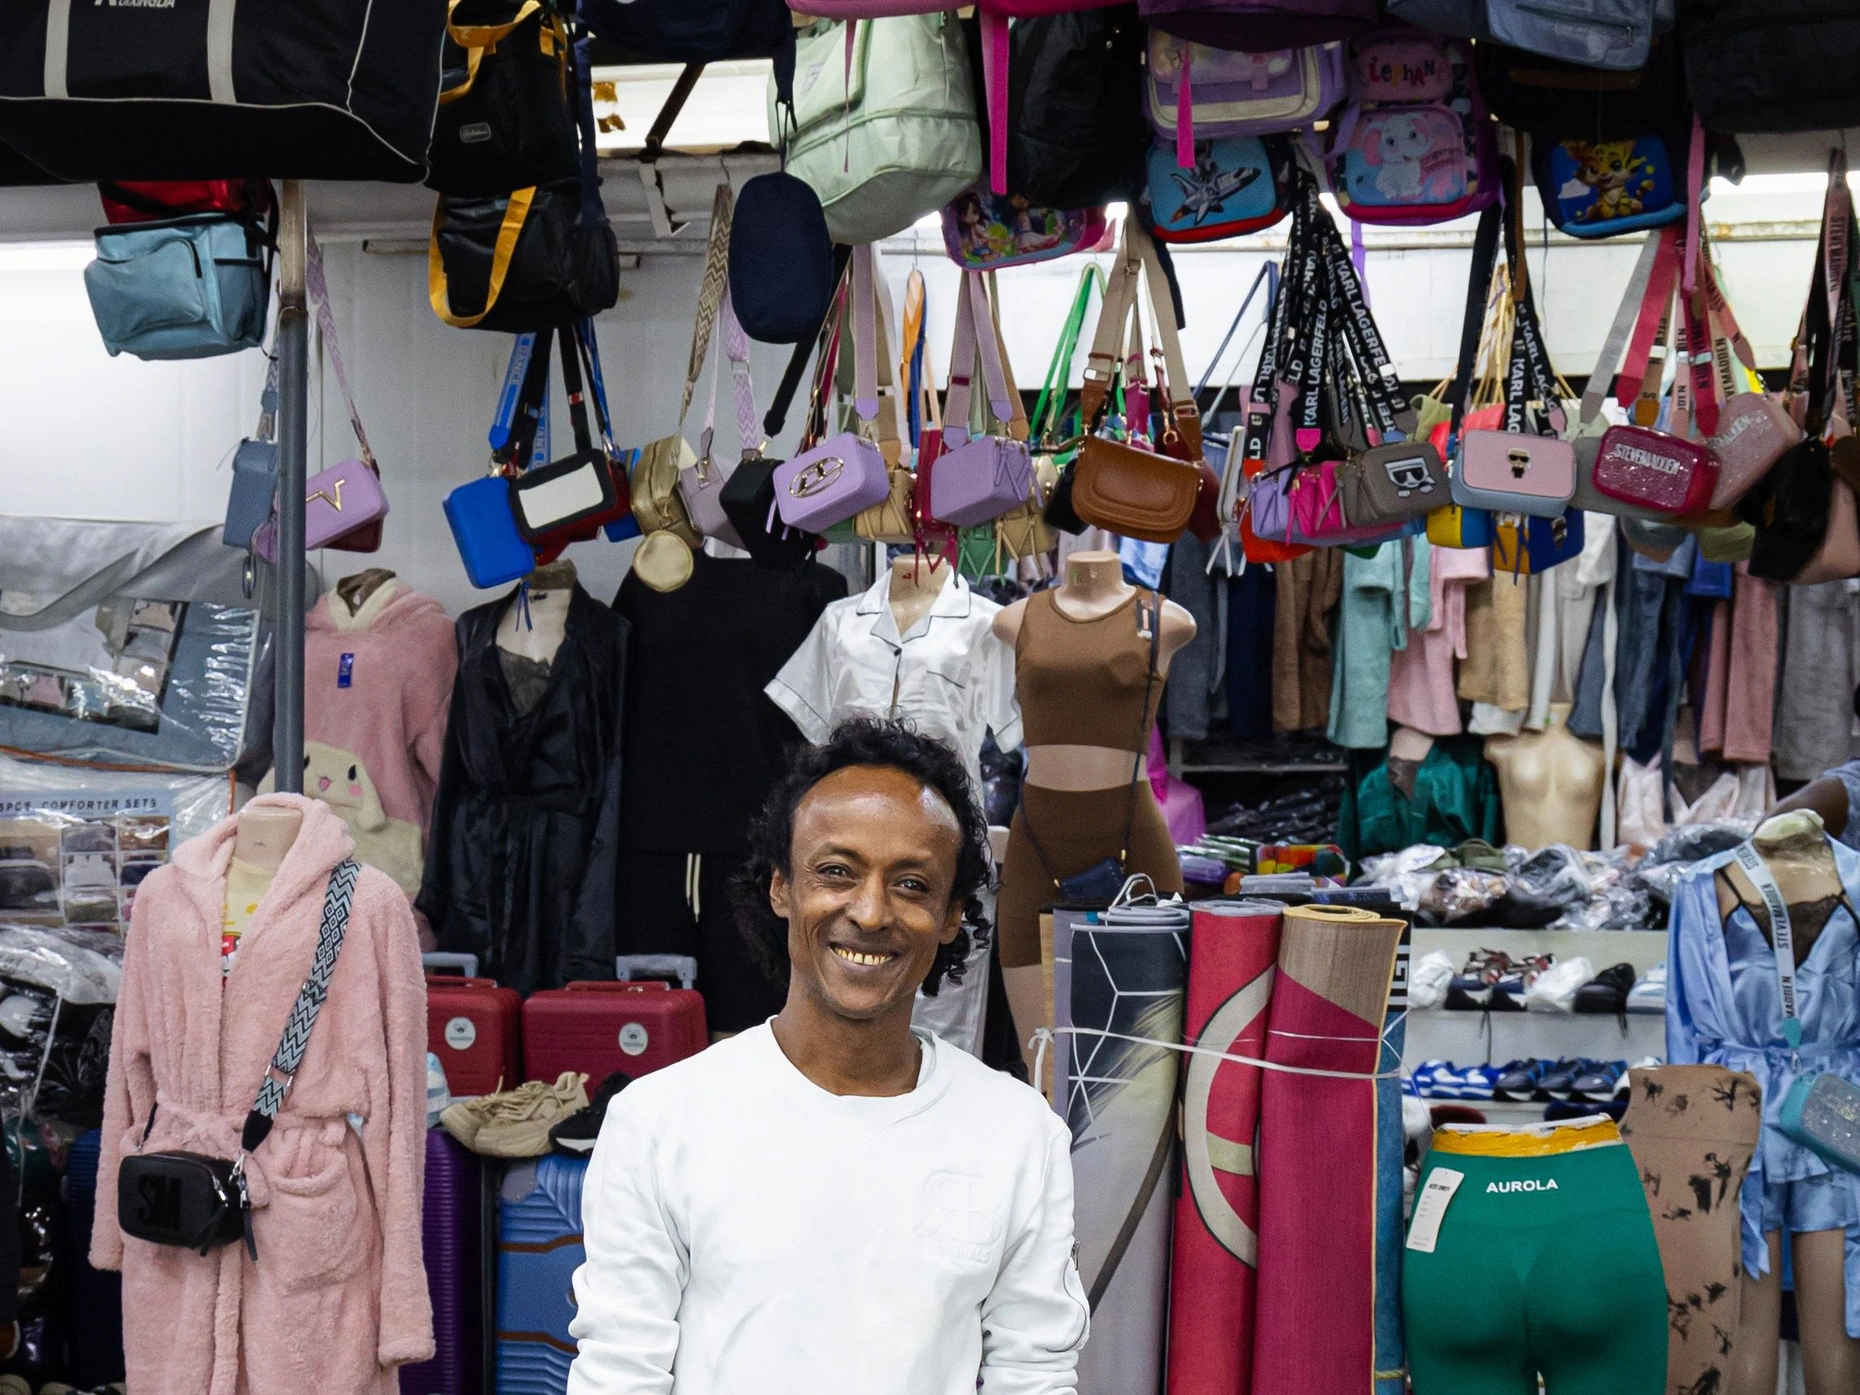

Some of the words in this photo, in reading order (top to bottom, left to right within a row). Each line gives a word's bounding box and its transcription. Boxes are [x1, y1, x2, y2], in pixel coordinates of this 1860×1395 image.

[1335, 259, 1358, 301] KARL
[1307, 299, 1328, 385] LAGERFELD
[1521, 320, 1541, 363] KARL
[1509, 358, 1526, 401] KARL
[1303, 387, 1319, 426] KARL
[42, 799, 119, 810] COMFORTER
[125, 798, 157, 808] SETS
[1486, 1178, 1559, 1194] AUROLA
